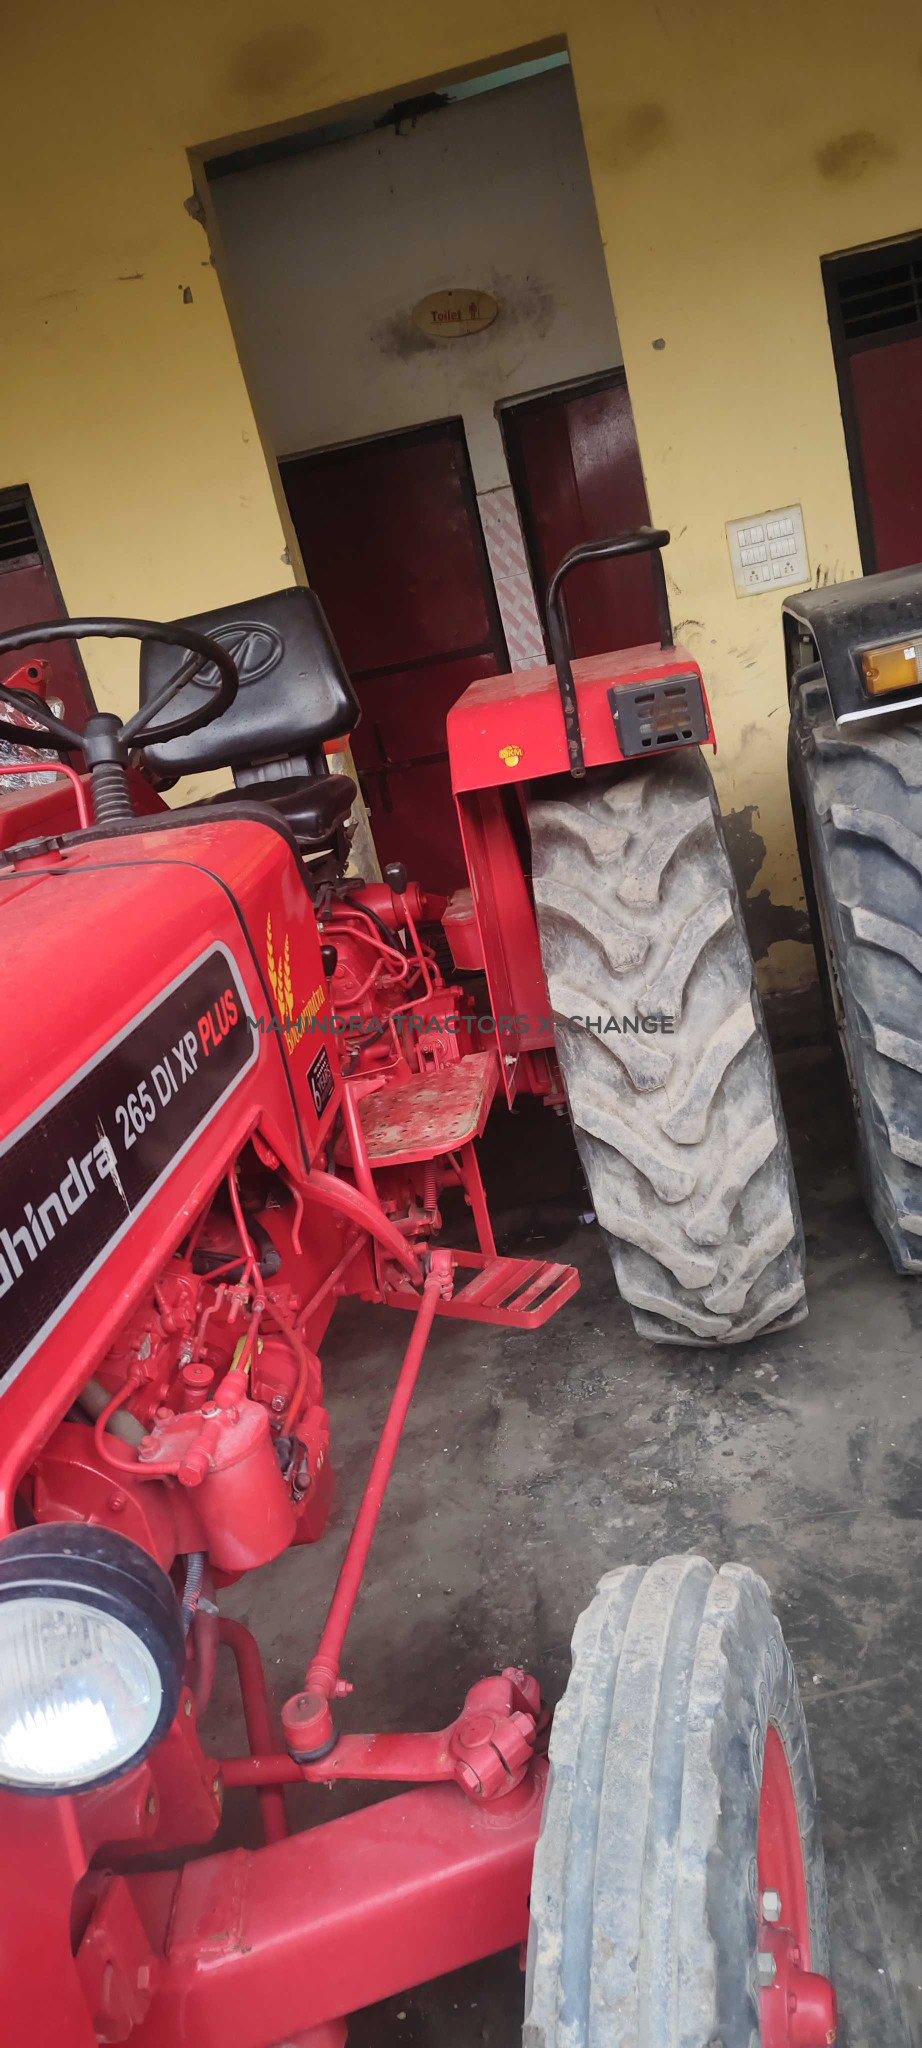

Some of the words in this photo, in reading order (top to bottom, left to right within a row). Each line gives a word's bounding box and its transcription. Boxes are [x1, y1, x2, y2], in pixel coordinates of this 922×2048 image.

[431, 309, 462, 322] Toilet
[115, 1080, 156, 1150] 265
[150, 1056, 179, 1107] DI
[171, 1031, 198, 1084] XP
[197, 989, 239, 1057] PLUS
